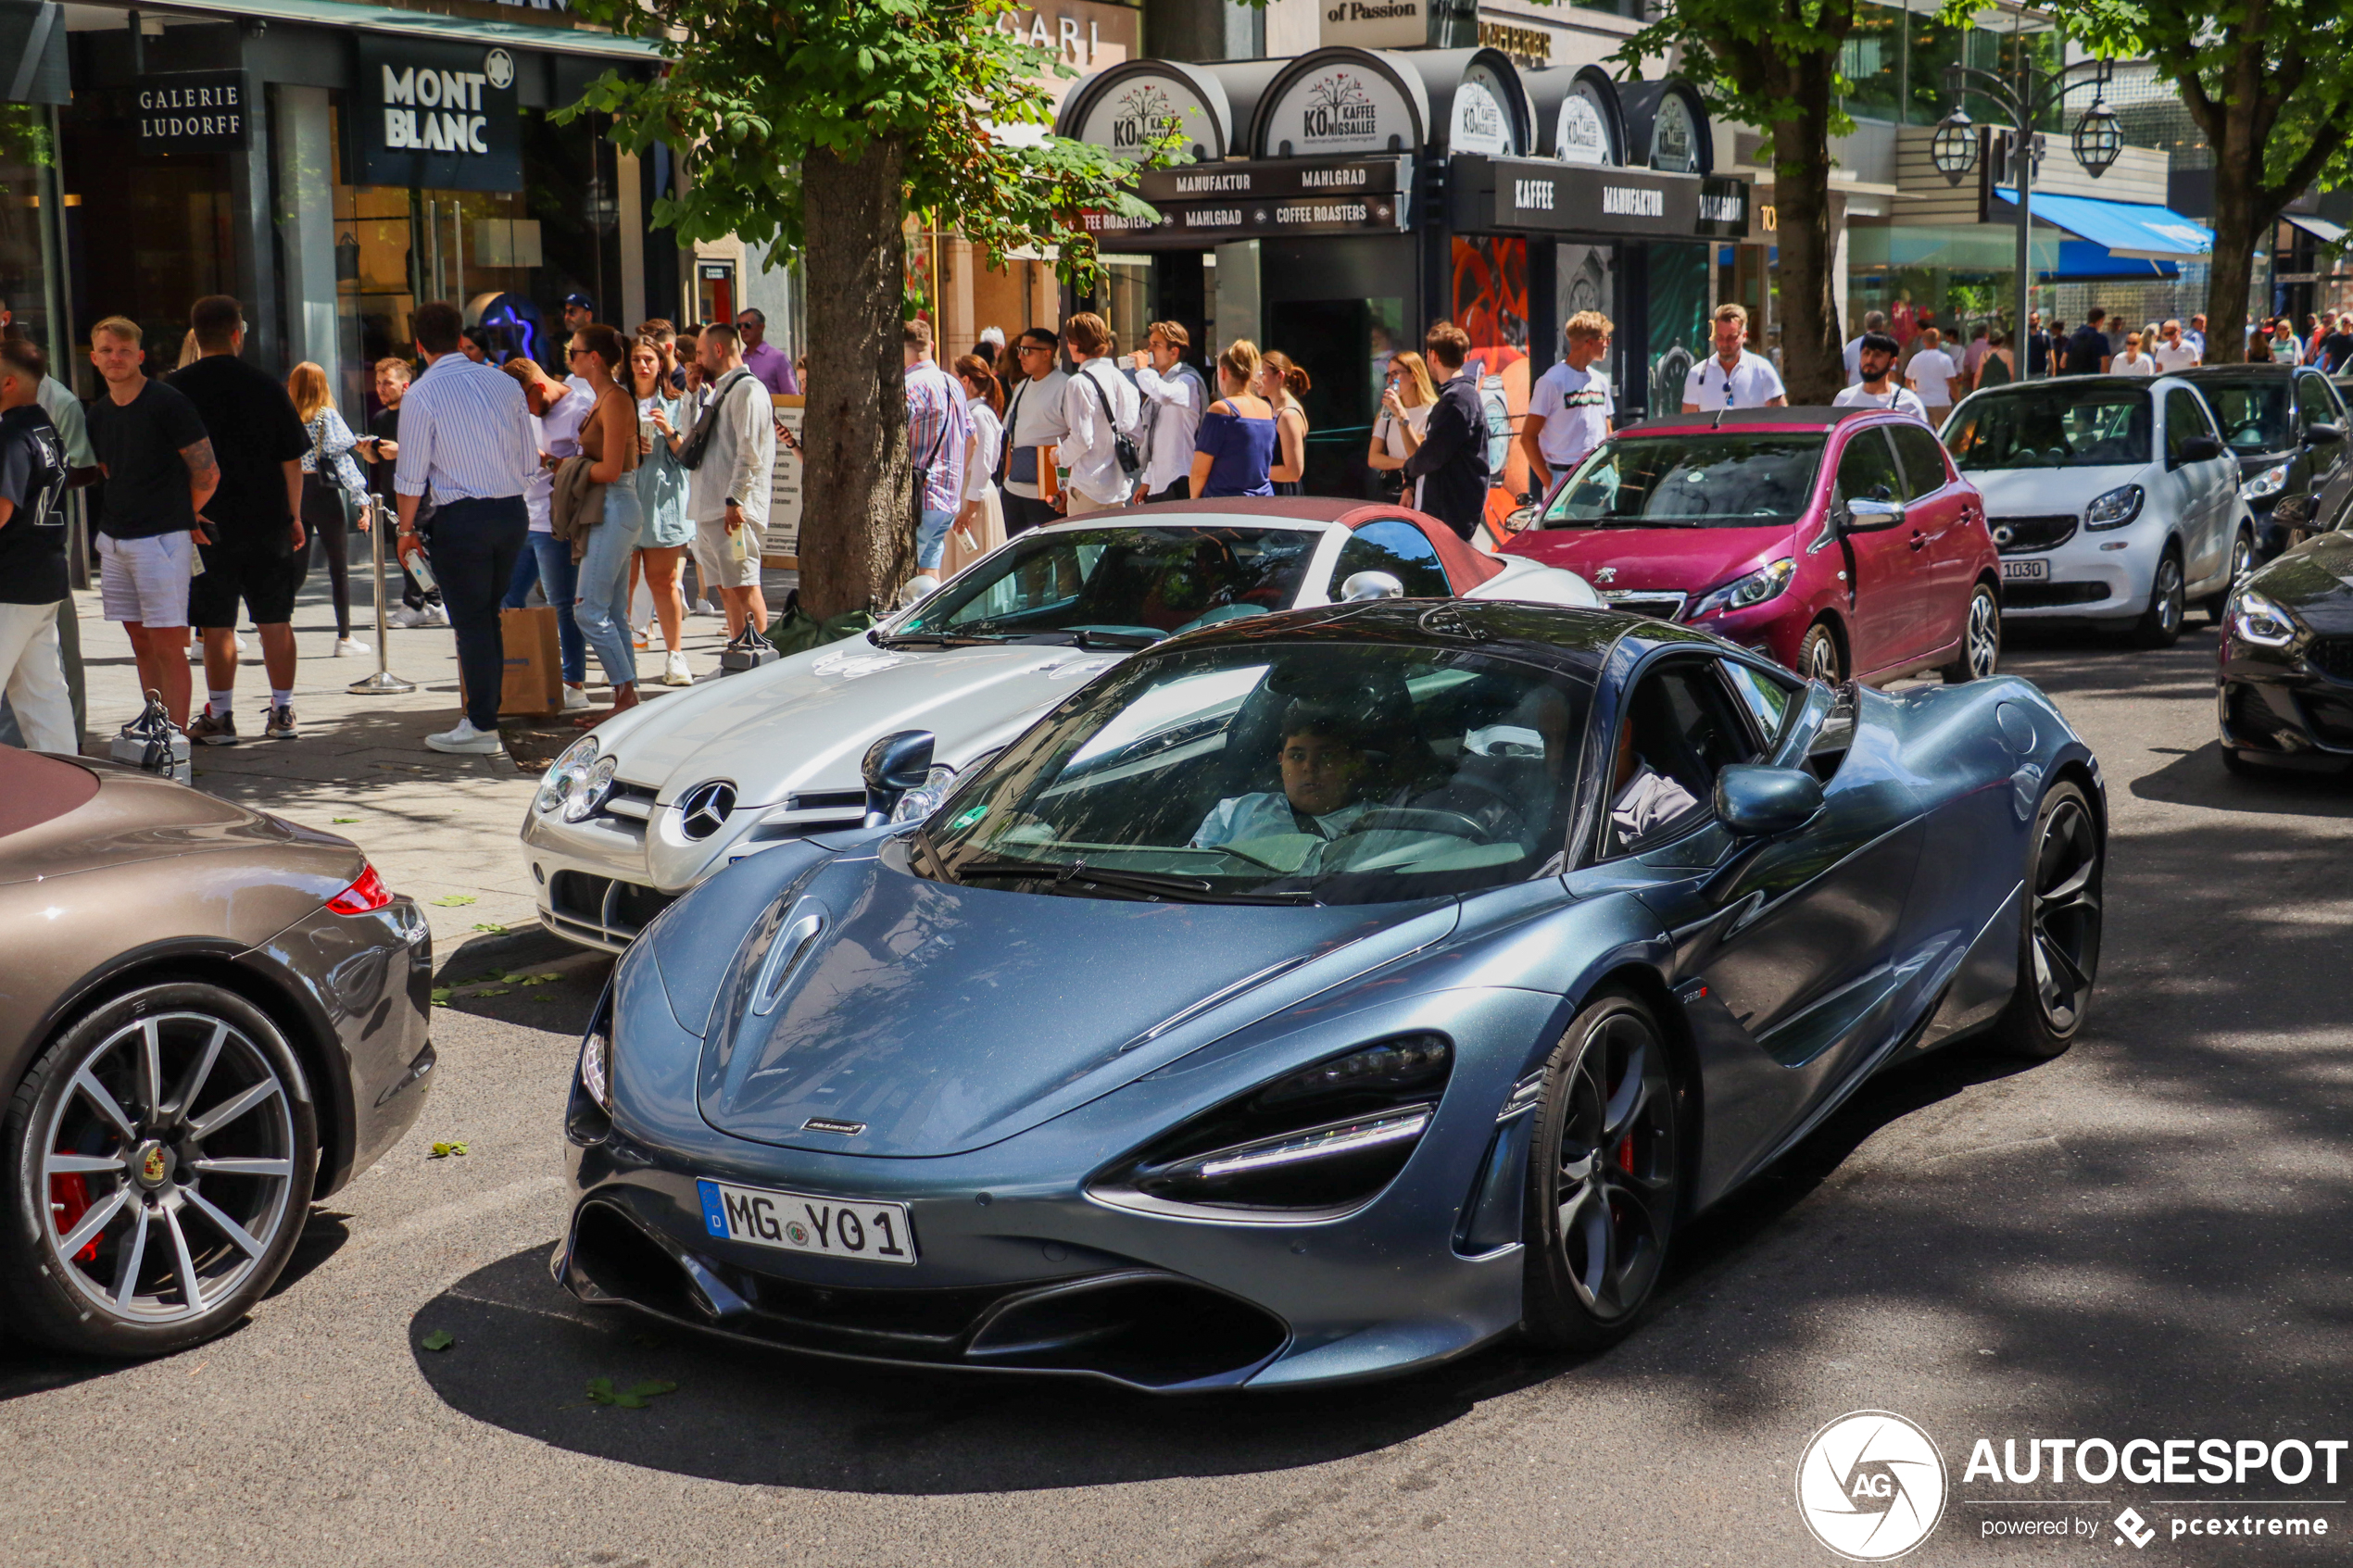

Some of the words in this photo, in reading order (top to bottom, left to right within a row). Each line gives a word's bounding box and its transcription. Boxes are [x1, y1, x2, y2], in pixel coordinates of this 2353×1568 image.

[1327, 3, 1347, 21] of
[1350, 0, 1416, 20] Passion
[140, 87, 238, 109] GALERIE
[383, 64, 487, 111] MONT
[1342, 105, 1376, 119] KAFFEE
[142, 115, 240, 137] LUDORFF
[384, 108, 488, 153] BLANC
[1176, 174, 1251, 193] MANUFAKTUR
[1302, 169, 1366, 188] MAHLGRAD
[1516, 180, 1554, 210] KAFFEE
[1604, 186, 1664, 217] MANUFAKTUR
[1102, 213, 1152, 230] ROASTERS
[1186, 209, 1242, 227] MAHLGRAD
[1277, 207, 1312, 223] COFFEE
[1314, 204, 1367, 221] ROASTERS
[1761, 205, 1777, 232] TO
[2004, 562, 2042, 578] 1030
[711, 1215, 721, 1228] D
[724, 1192, 783, 1241] MG
